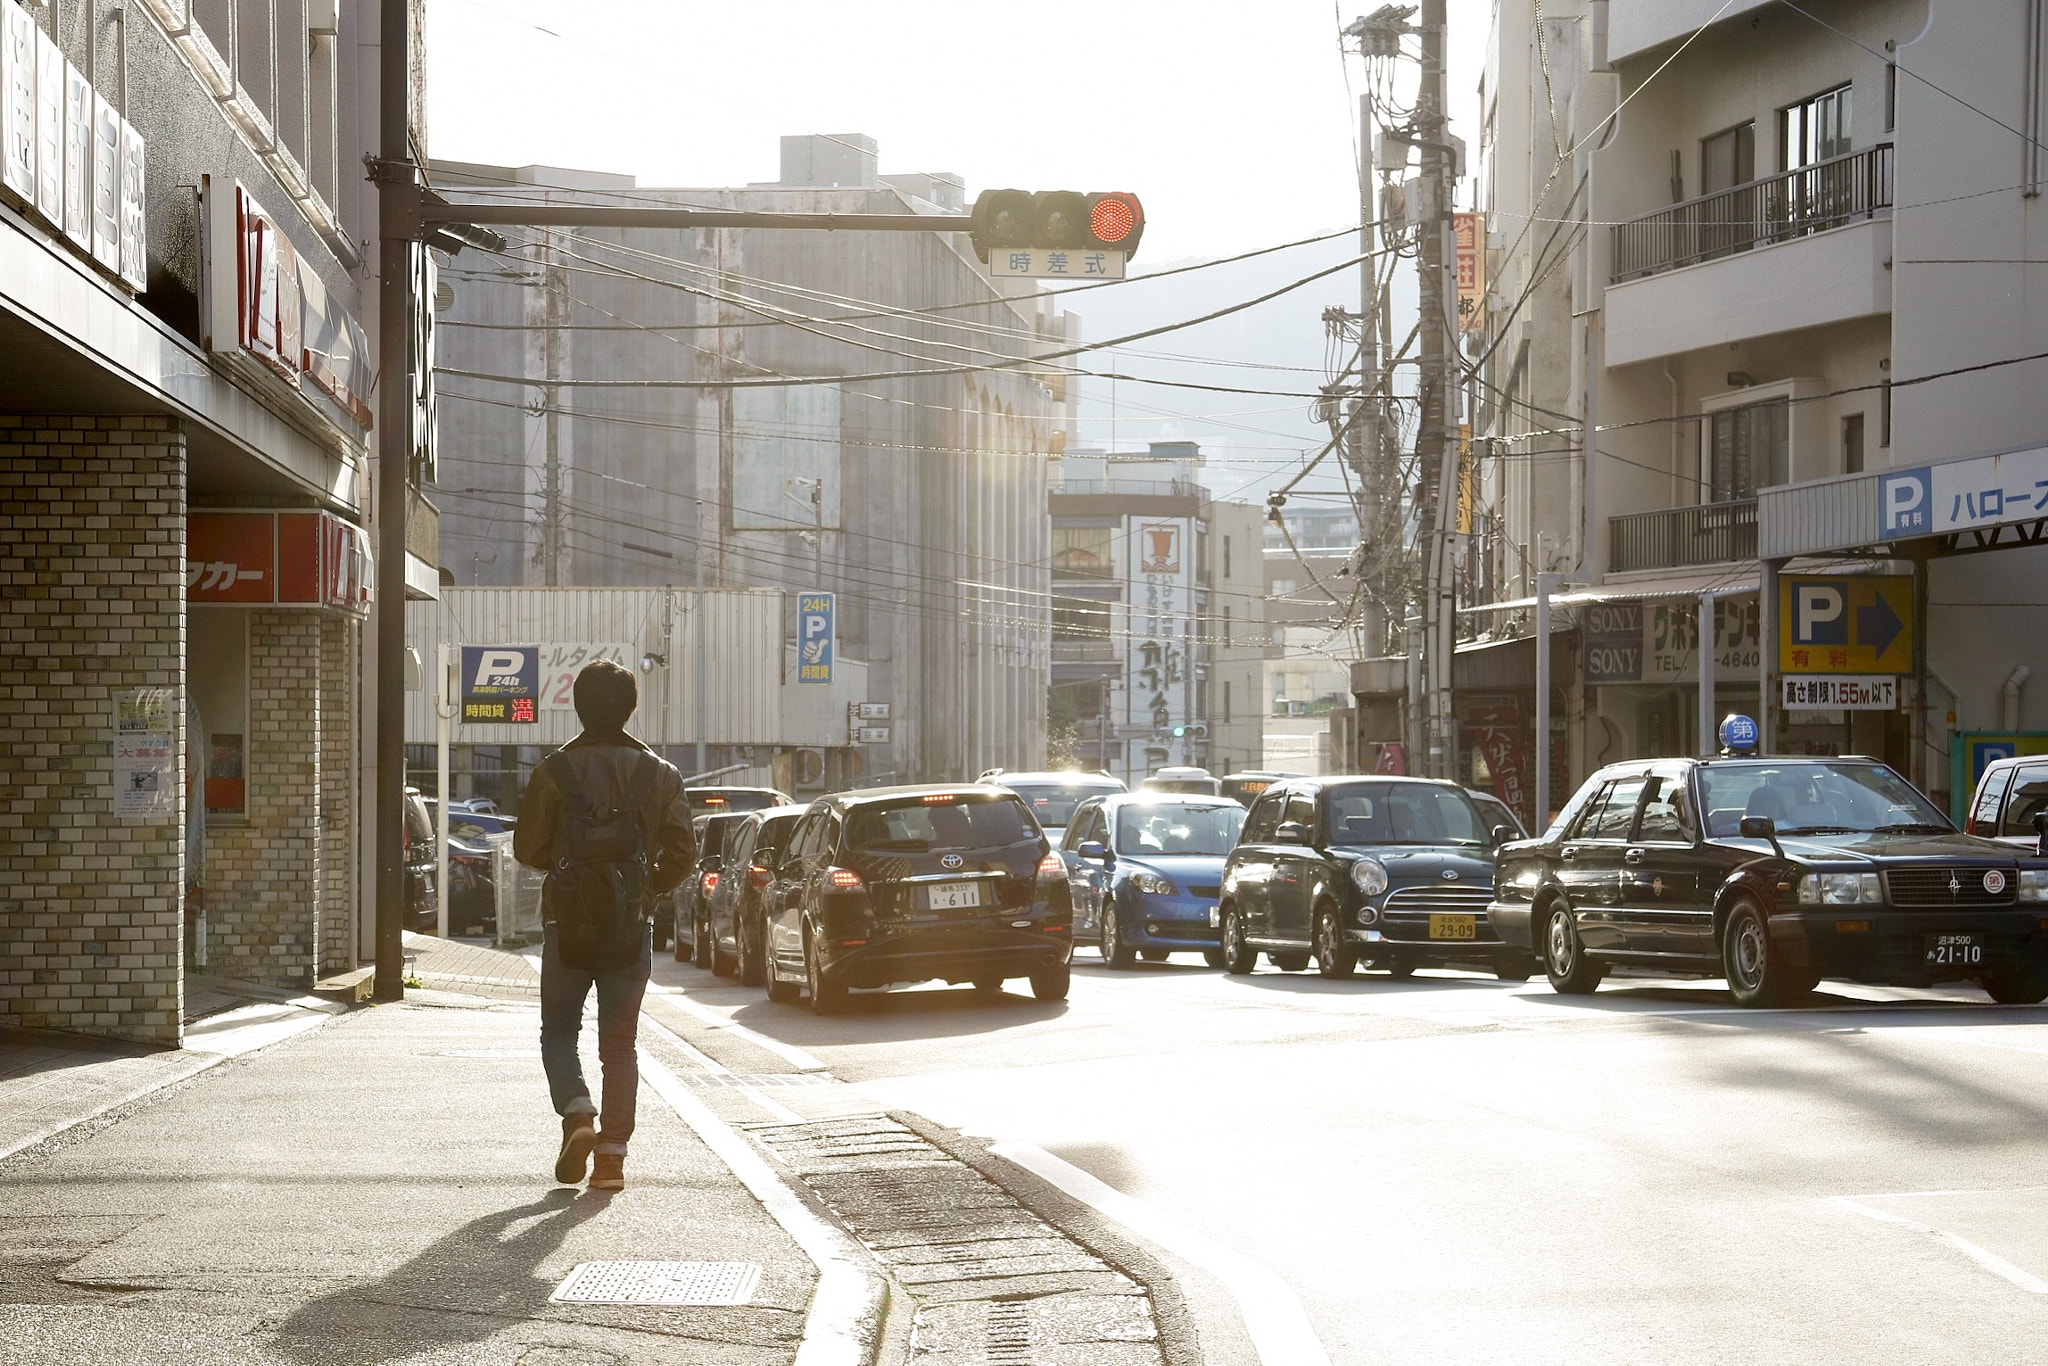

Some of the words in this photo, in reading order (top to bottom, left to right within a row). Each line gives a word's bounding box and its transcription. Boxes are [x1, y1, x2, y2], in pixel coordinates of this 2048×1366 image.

[1009, 252, 1106, 275] 時差式
[1886, 476, 1924, 530] P
[1900, 511, 1922, 528] 有料
[803, 597, 830, 613] 24H
[1798, 586, 1843, 640] P
[806, 615, 826, 638] P
[1590, 606, 1637, 633] SONY
[475, 650, 524, 686] P
[1589, 648, 1638, 674] SONY
[1791, 650, 1848, 668] 有料
[491, 676, 520, 687] 24h
[802, 666, 829, 679] 時間貸
[466, 704, 505, 718] 時間貸
[512, 699, 534, 722] 満
[1732, 721, 1754, 744] 第一
[1440, 925, 1473, 937] 29-09
[1956, 936, 1971, 945] 500
[1937, 946, 1981, 963] 21-10
